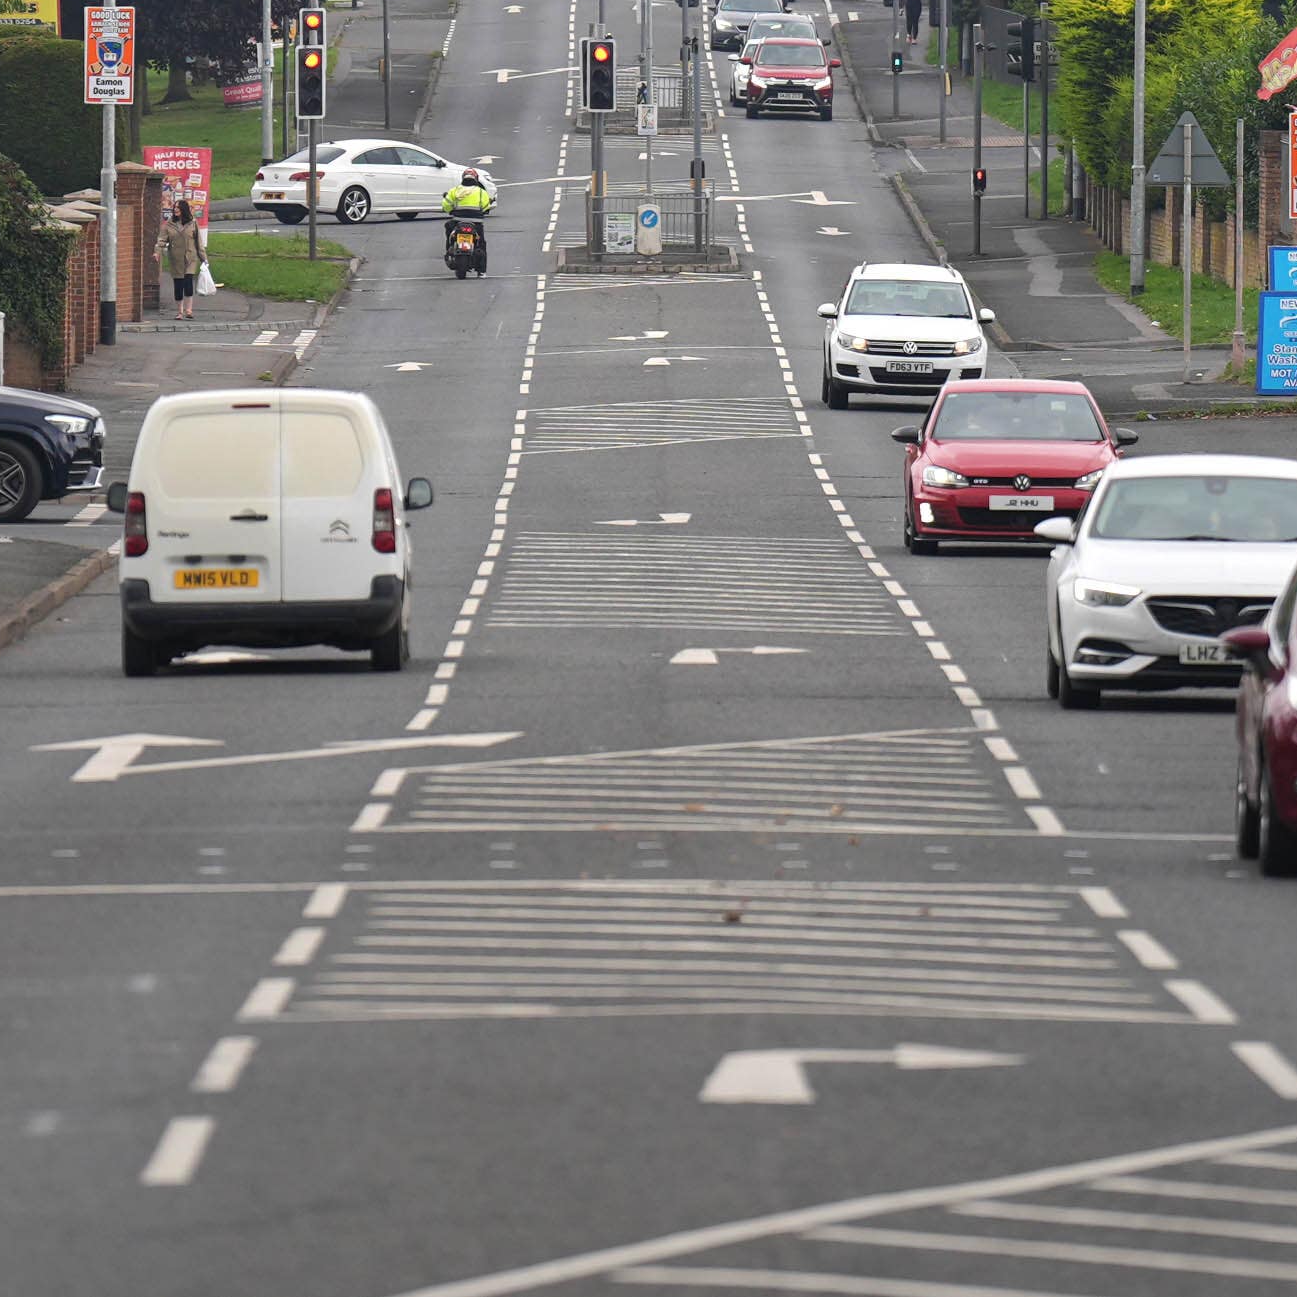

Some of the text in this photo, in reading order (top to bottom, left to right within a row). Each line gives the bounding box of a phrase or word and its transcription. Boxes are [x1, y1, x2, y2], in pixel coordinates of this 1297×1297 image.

[91, 11, 130, 20] GOOD LUCK
[96, 78, 123, 86] Eamon
[93, 87, 125, 97] Douglas
[155, 151, 199, 160] HALF PRICE
[153, 159, 201, 170] HEROES
[1270, 369, 1293, 378] MOT
[219, 571, 250, 586] VLD
[1186, 645, 1219, 661] LHZ
